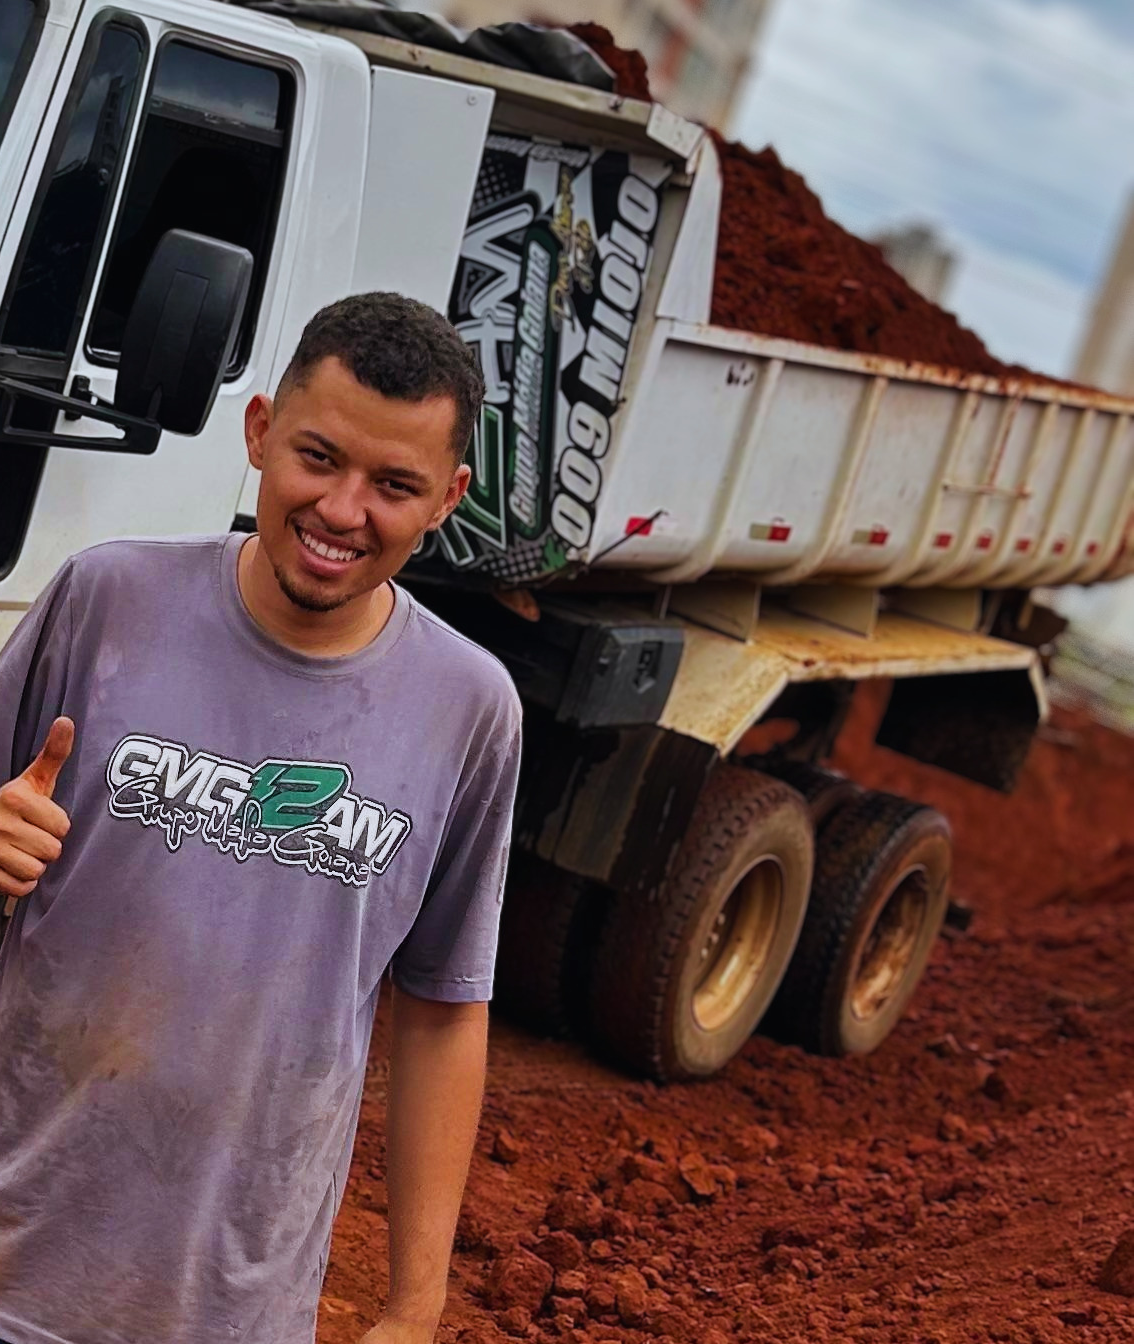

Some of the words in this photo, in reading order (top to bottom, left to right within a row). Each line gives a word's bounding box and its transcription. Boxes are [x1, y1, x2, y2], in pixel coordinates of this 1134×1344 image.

[516, 239, 551, 355] Goiana
[578, 174, 659, 403] MIOJO
[508, 430, 540, 528] Grupo
[551, 400, 610, 548] 009
[113, 776, 197, 837] Grupo
[277, 823, 371, 876] Goiana
